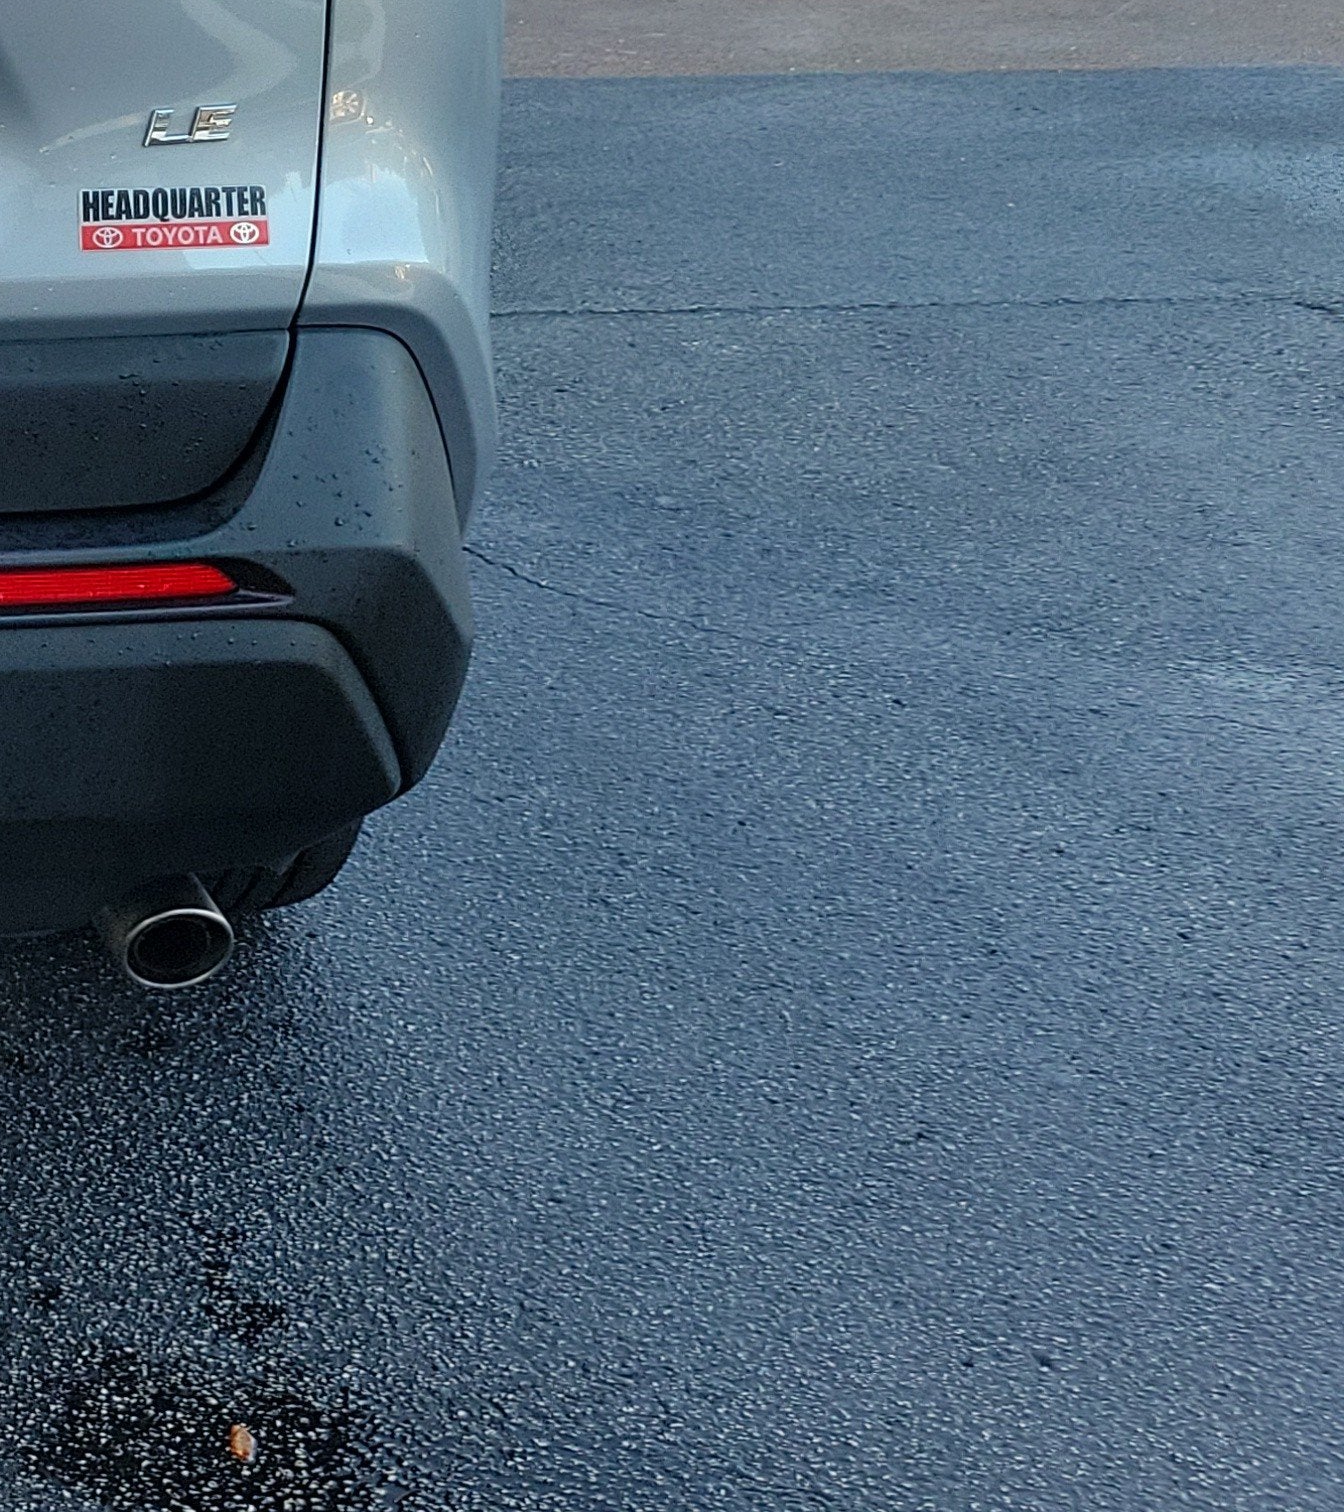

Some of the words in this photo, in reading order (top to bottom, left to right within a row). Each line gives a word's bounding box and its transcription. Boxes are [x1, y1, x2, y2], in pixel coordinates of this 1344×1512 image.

[141, 102, 238, 148] LE
[81, 185, 267, 223] HEADQUARTER
[131, 225, 223, 246] TOYOTA
